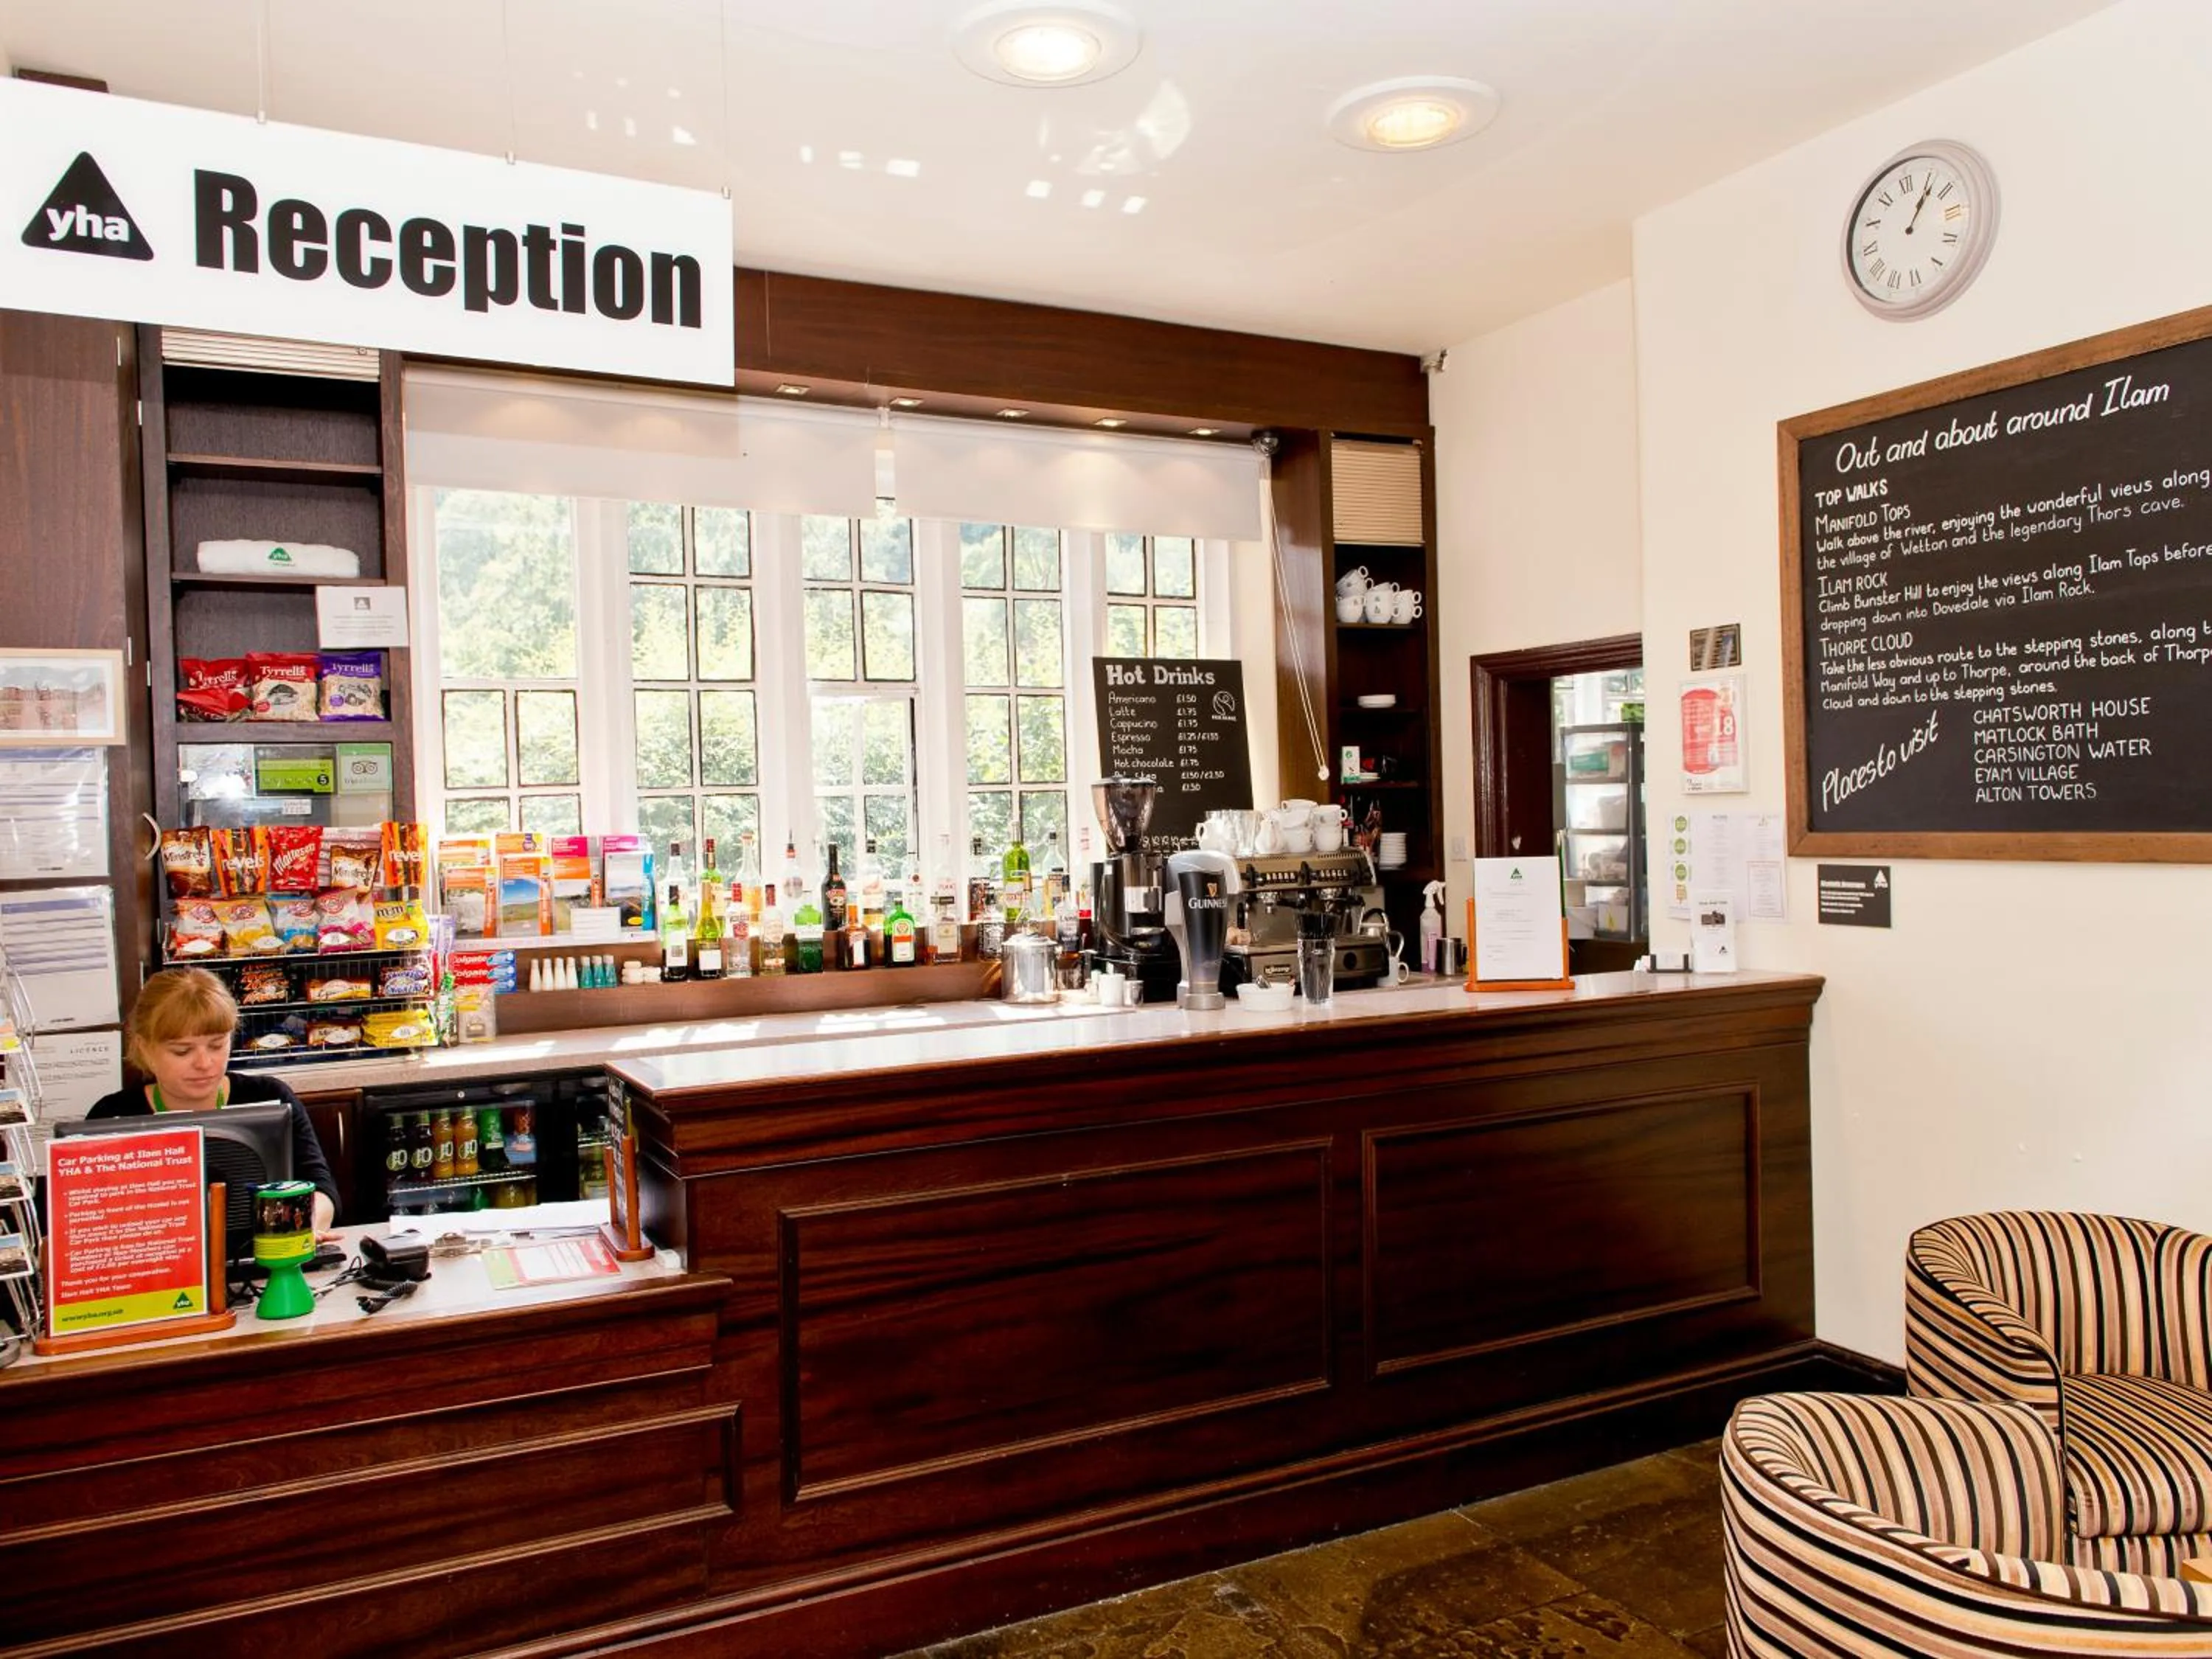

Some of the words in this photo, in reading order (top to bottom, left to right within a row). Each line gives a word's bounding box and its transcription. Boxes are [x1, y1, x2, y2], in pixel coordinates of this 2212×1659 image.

[46, 204, 131, 243] yha
[193, 168, 702, 329] Reception
[1836, 437, 1881, 473] Out
[1886, 431, 1928, 461] and
[1935, 411, 2000, 451] about
[2006, 393, 2093, 434] around
[2100, 375, 2170, 417] Ilam
[1815, 489, 1842, 509] TOP
[1846, 479, 1888, 502] WALKS
[1815, 511, 1878, 536] MANIFOLD
[1816, 538, 1843, 553] Walk
[1847, 533, 1879, 547] above
[1884, 526, 1902, 540] the
[1905, 523, 1935, 537] river,
[1941, 512, 1995, 532] enjoying
[2000, 504, 2021, 520] the
[2027, 483, 2101, 514] wonderful
[2163, 470, 2211, 489] along
[1817, 555, 1836, 570] the
[1840, 551, 1877, 568] village
[1880, 543, 1893, 560] of
[1900, 538, 1947, 556] Wetton
[1952, 530, 1977, 547] and
[1982, 528, 2005, 542] the
[2011, 515, 2081, 543] legendary
[2087, 504, 2132, 524] Thors
[2140, 497, 2185, 514] cave.
[1819, 597, 1850, 613] Climb
[1854, 590, 1902, 609] Bunster
[1905, 585, 1922, 601] Hill
[1927, 583, 1938, 597] to
[1942, 580, 1974, 598] enjoy
[1978, 574, 1998, 590] the
[2002, 571, 2038, 587] views
[2043, 563, 2082, 582] along
[2088, 554, 2122, 574] Ilam
[2125, 549, 2159, 571] Tops
[2164, 543, 2212, 562] before
[1856, 571, 1888, 591] ROCK
[1820, 616, 1866, 635] dropping
[1872, 611, 1902, 624] down
[1906, 607, 1928, 619] into
[1933, 596, 1989, 616] Dovedale
[1994, 593, 2015, 608] via
[2021, 585, 2053, 604] Ilam
[2059, 580, 2095, 598] Rock.
[1819, 638, 1868, 658] THORPE
[1871, 631, 1913, 652] CLOUD
[1820, 661, 1844, 676] Take
[1847, 657, 1865, 672] the
[1868, 656, 1887, 671] less
[1889, 653, 1934, 668] obvious
[1937, 645, 1974, 663] route
[1978, 644, 1992, 658] to
[1995, 642, 2017, 657] the
[2024, 638, 2082, 657] stepping
[2090, 630, 2143, 647] stones,
[2150, 622, 2197, 644] along
[1105, 664, 1146, 686] Hot
[1153, 665, 1215, 685] Drinks
[1820, 673, 1868, 693] Manifold
[1873, 672, 1896, 692] Way
[1899, 669, 1921, 686] and
[1926, 672, 1940, 686] up
[1943, 668, 1957, 681] to
[1961, 664, 2011, 683] Thorpe,
[2019, 655, 2070, 674] around
[2074, 654, 2096, 669] the
[2101, 648, 2136, 667] back
[2143, 645, 2160, 662] of
[1108, 691, 1156, 704] Americano
[1823, 695, 1853, 710] Cloud
[1857, 694, 1878, 706] and
[1882, 692, 1911, 706] down
[1914, 689, 1927, 703] to
[1930, 686, 1949, 700] the
[1954, 685, 2005, 703] stepping
[2011, 680, 2058, 695] stones.
[1109, 706, 1136, 717] Latte
[1973, 702, 2081, 725] CHATSWORTH
[2092, 697, 2151, 717] HOUSE
[1111, 731, 1151, 744] Espresso
[1901, 709, 1939, 762] visit
[1974, 726, 2046, 745] MATLOCK
[2052, 722, 2098, 741] BATH
[1113, 745, 1144, 755] Mocha
[1114, 758, 1130, 768] Hot
[1131, 758, 1174, 768] chocolate
[1974, 744, 2080, 765] CARSINGTON
[2088, 738, 2152, 759] WATER
[1975, 766, 2012, 785] EYAM
[2017, 764, 2079, 782] VILLAGE
[1975, 785, 2022, 803] ALTON
[2027, 783, 2097, 801] TOWERS
[58, 1158, 77, 1166] Car
[80, 1153, 121, 1164] Parking
[124, 1151, 133, 1159] at
[164, 1147, 184, 1155] Hall
[58, 1167, 81, 1177] YHA
[85, 1166, 93, 1174] &
[96, 1164, 116, 1172] The
[119, 1158, 163, 1170] National
[166, 1155, 192, 1165] Trust
